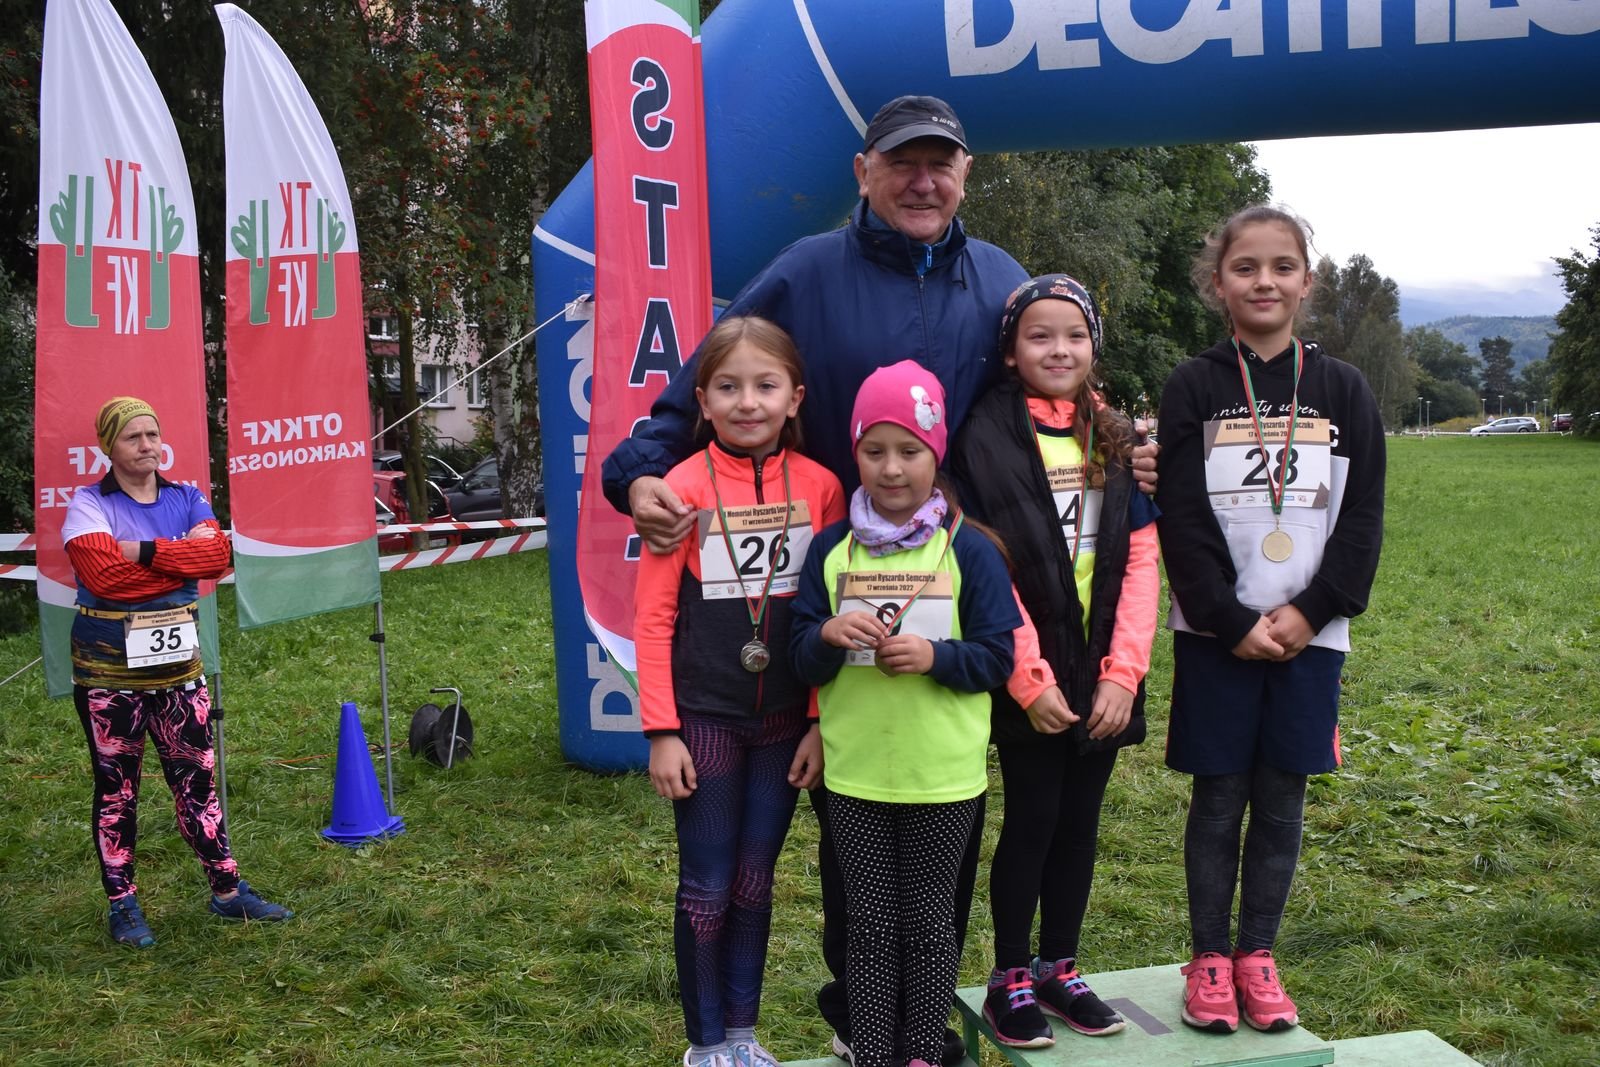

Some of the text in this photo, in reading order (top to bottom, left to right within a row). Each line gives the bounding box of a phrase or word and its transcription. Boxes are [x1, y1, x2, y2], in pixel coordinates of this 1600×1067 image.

[1220, 400, 1272, 418] ninty
[1287, 421, 1314, 429] Sczuka
[1241, 447, 1299, 486] 28
[1059, 493, 1081, 533] 4
[739, 533, 790, 575] 26
[878, 573, 904, 583] Ryszarda
[149, 626, 182, 653] 35
